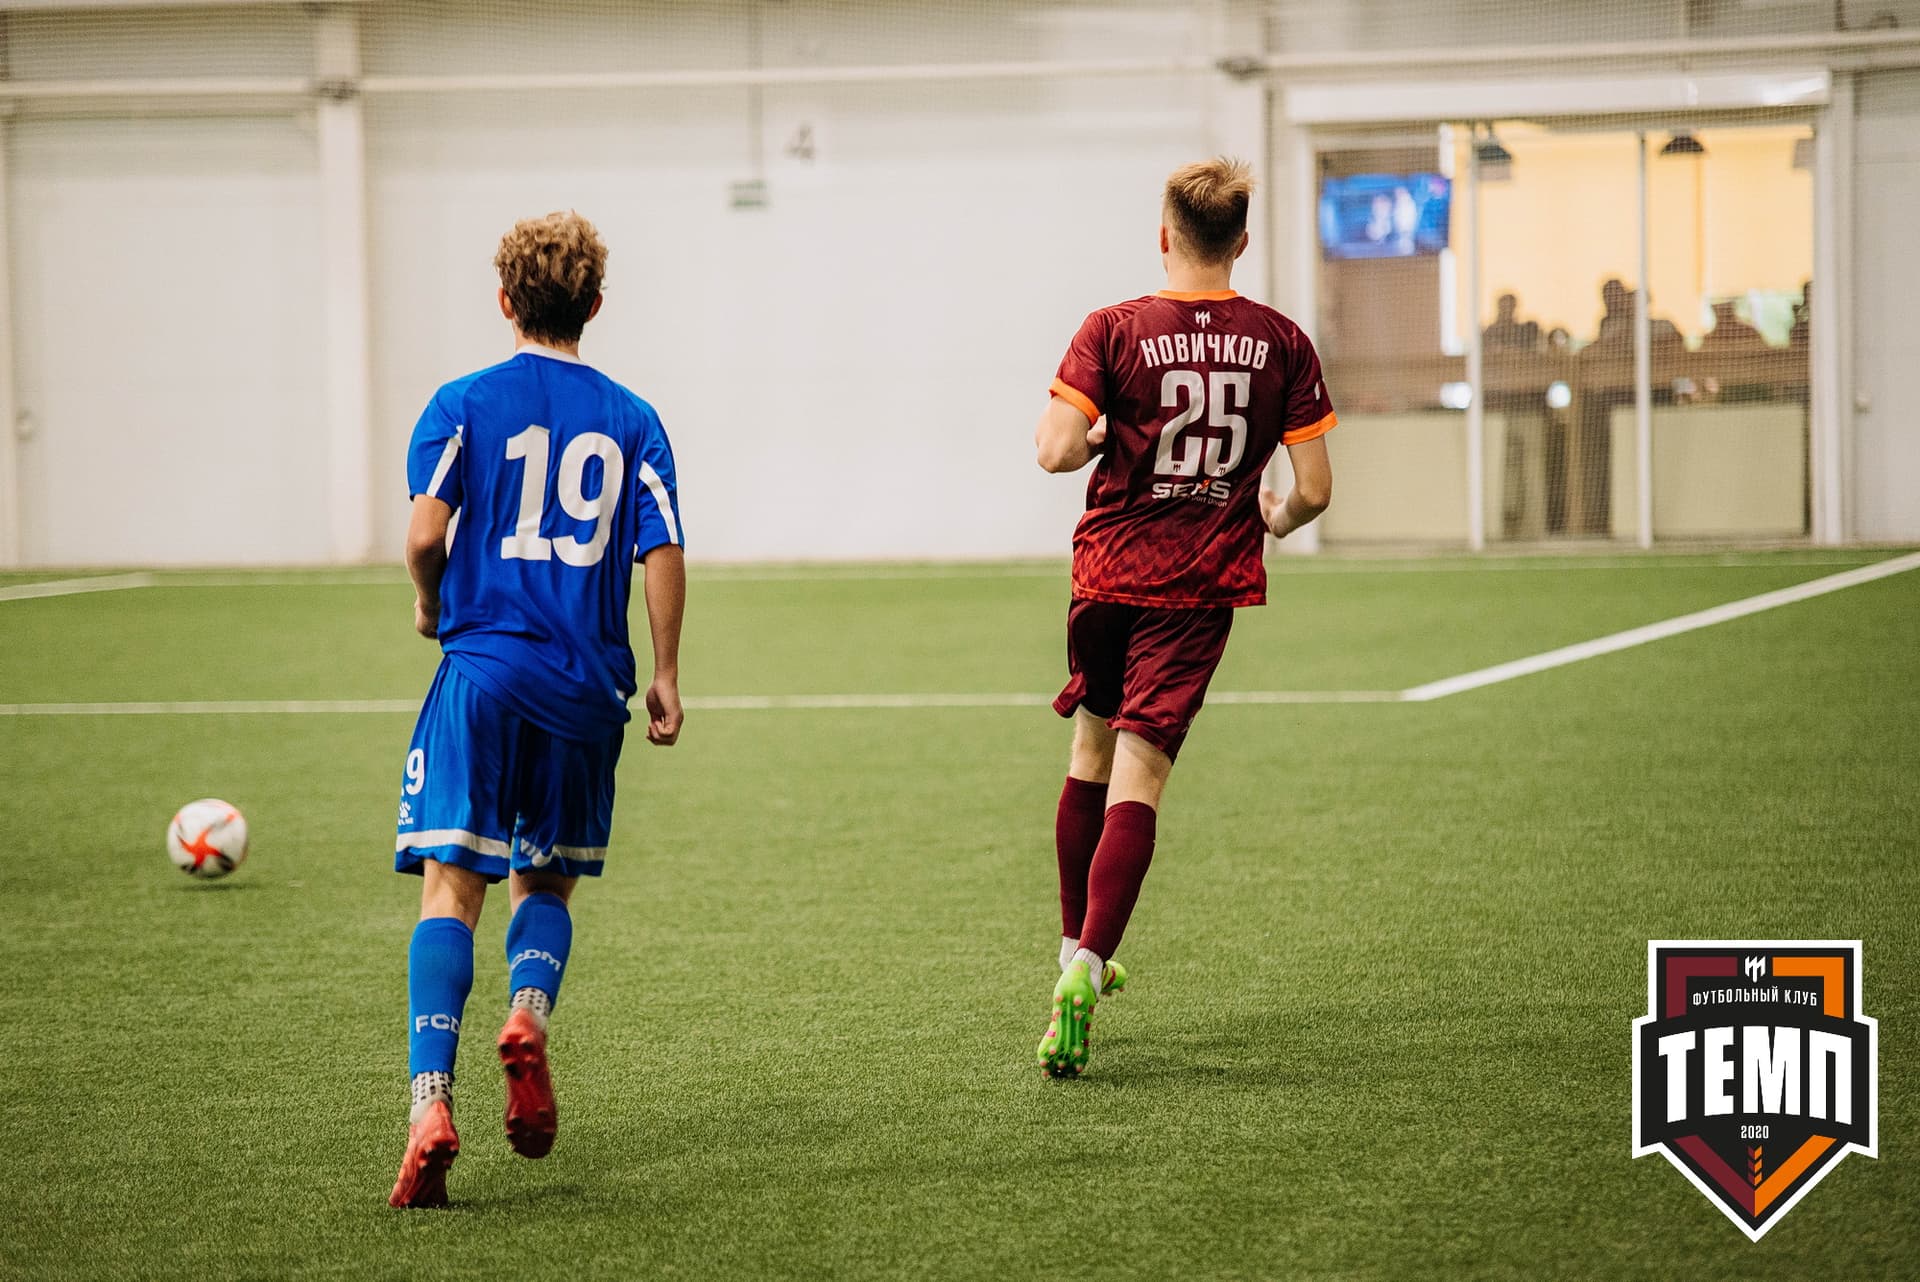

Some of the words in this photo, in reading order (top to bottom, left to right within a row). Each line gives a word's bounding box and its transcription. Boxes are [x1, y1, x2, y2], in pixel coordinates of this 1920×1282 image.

[1140, 333, 1269, 370] НОВИЧКОВ
[1154, 370, 1251, 477] 25
[501, 424, 624, 567] 19
[401, 748, 425, 797] 9
